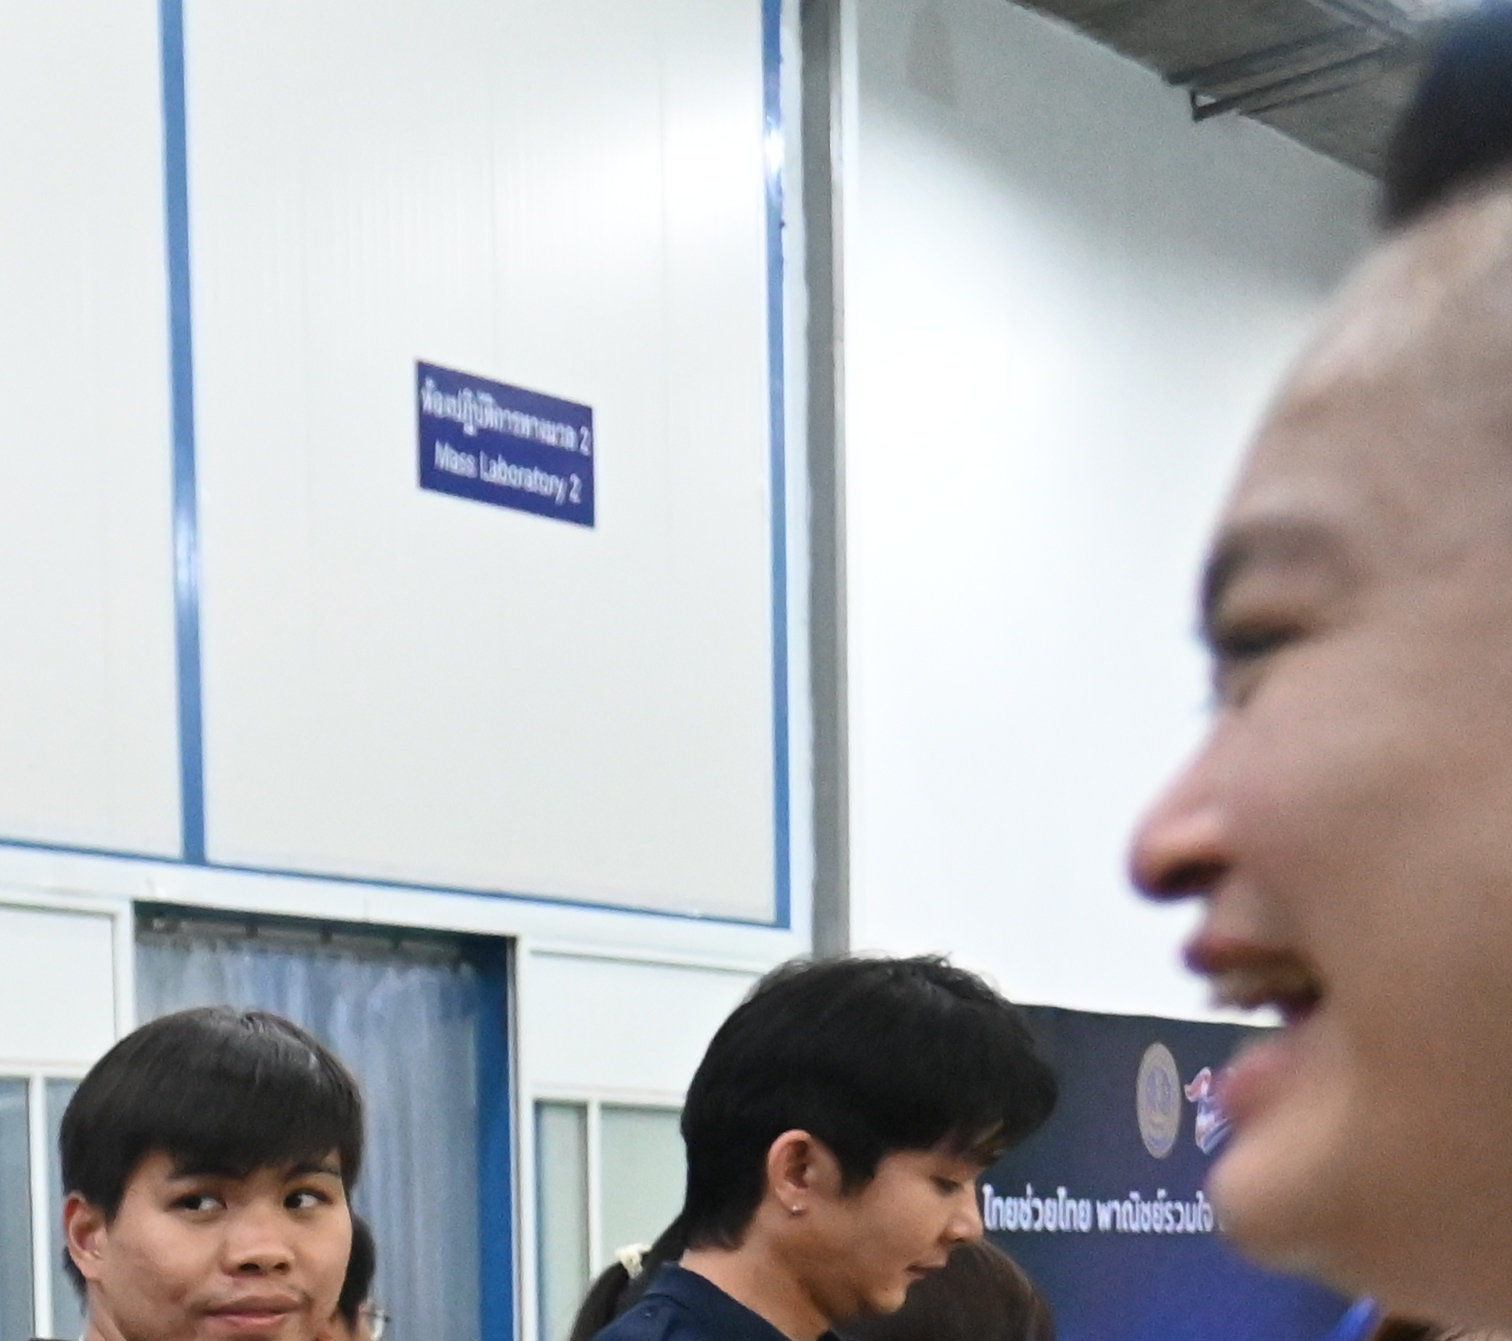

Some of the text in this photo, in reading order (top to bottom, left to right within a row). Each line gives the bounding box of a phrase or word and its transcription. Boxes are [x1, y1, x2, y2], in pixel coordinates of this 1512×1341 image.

[579, 425, 592, 457] 2
[434, 439, 583, 506] Mass Laboratory 2
